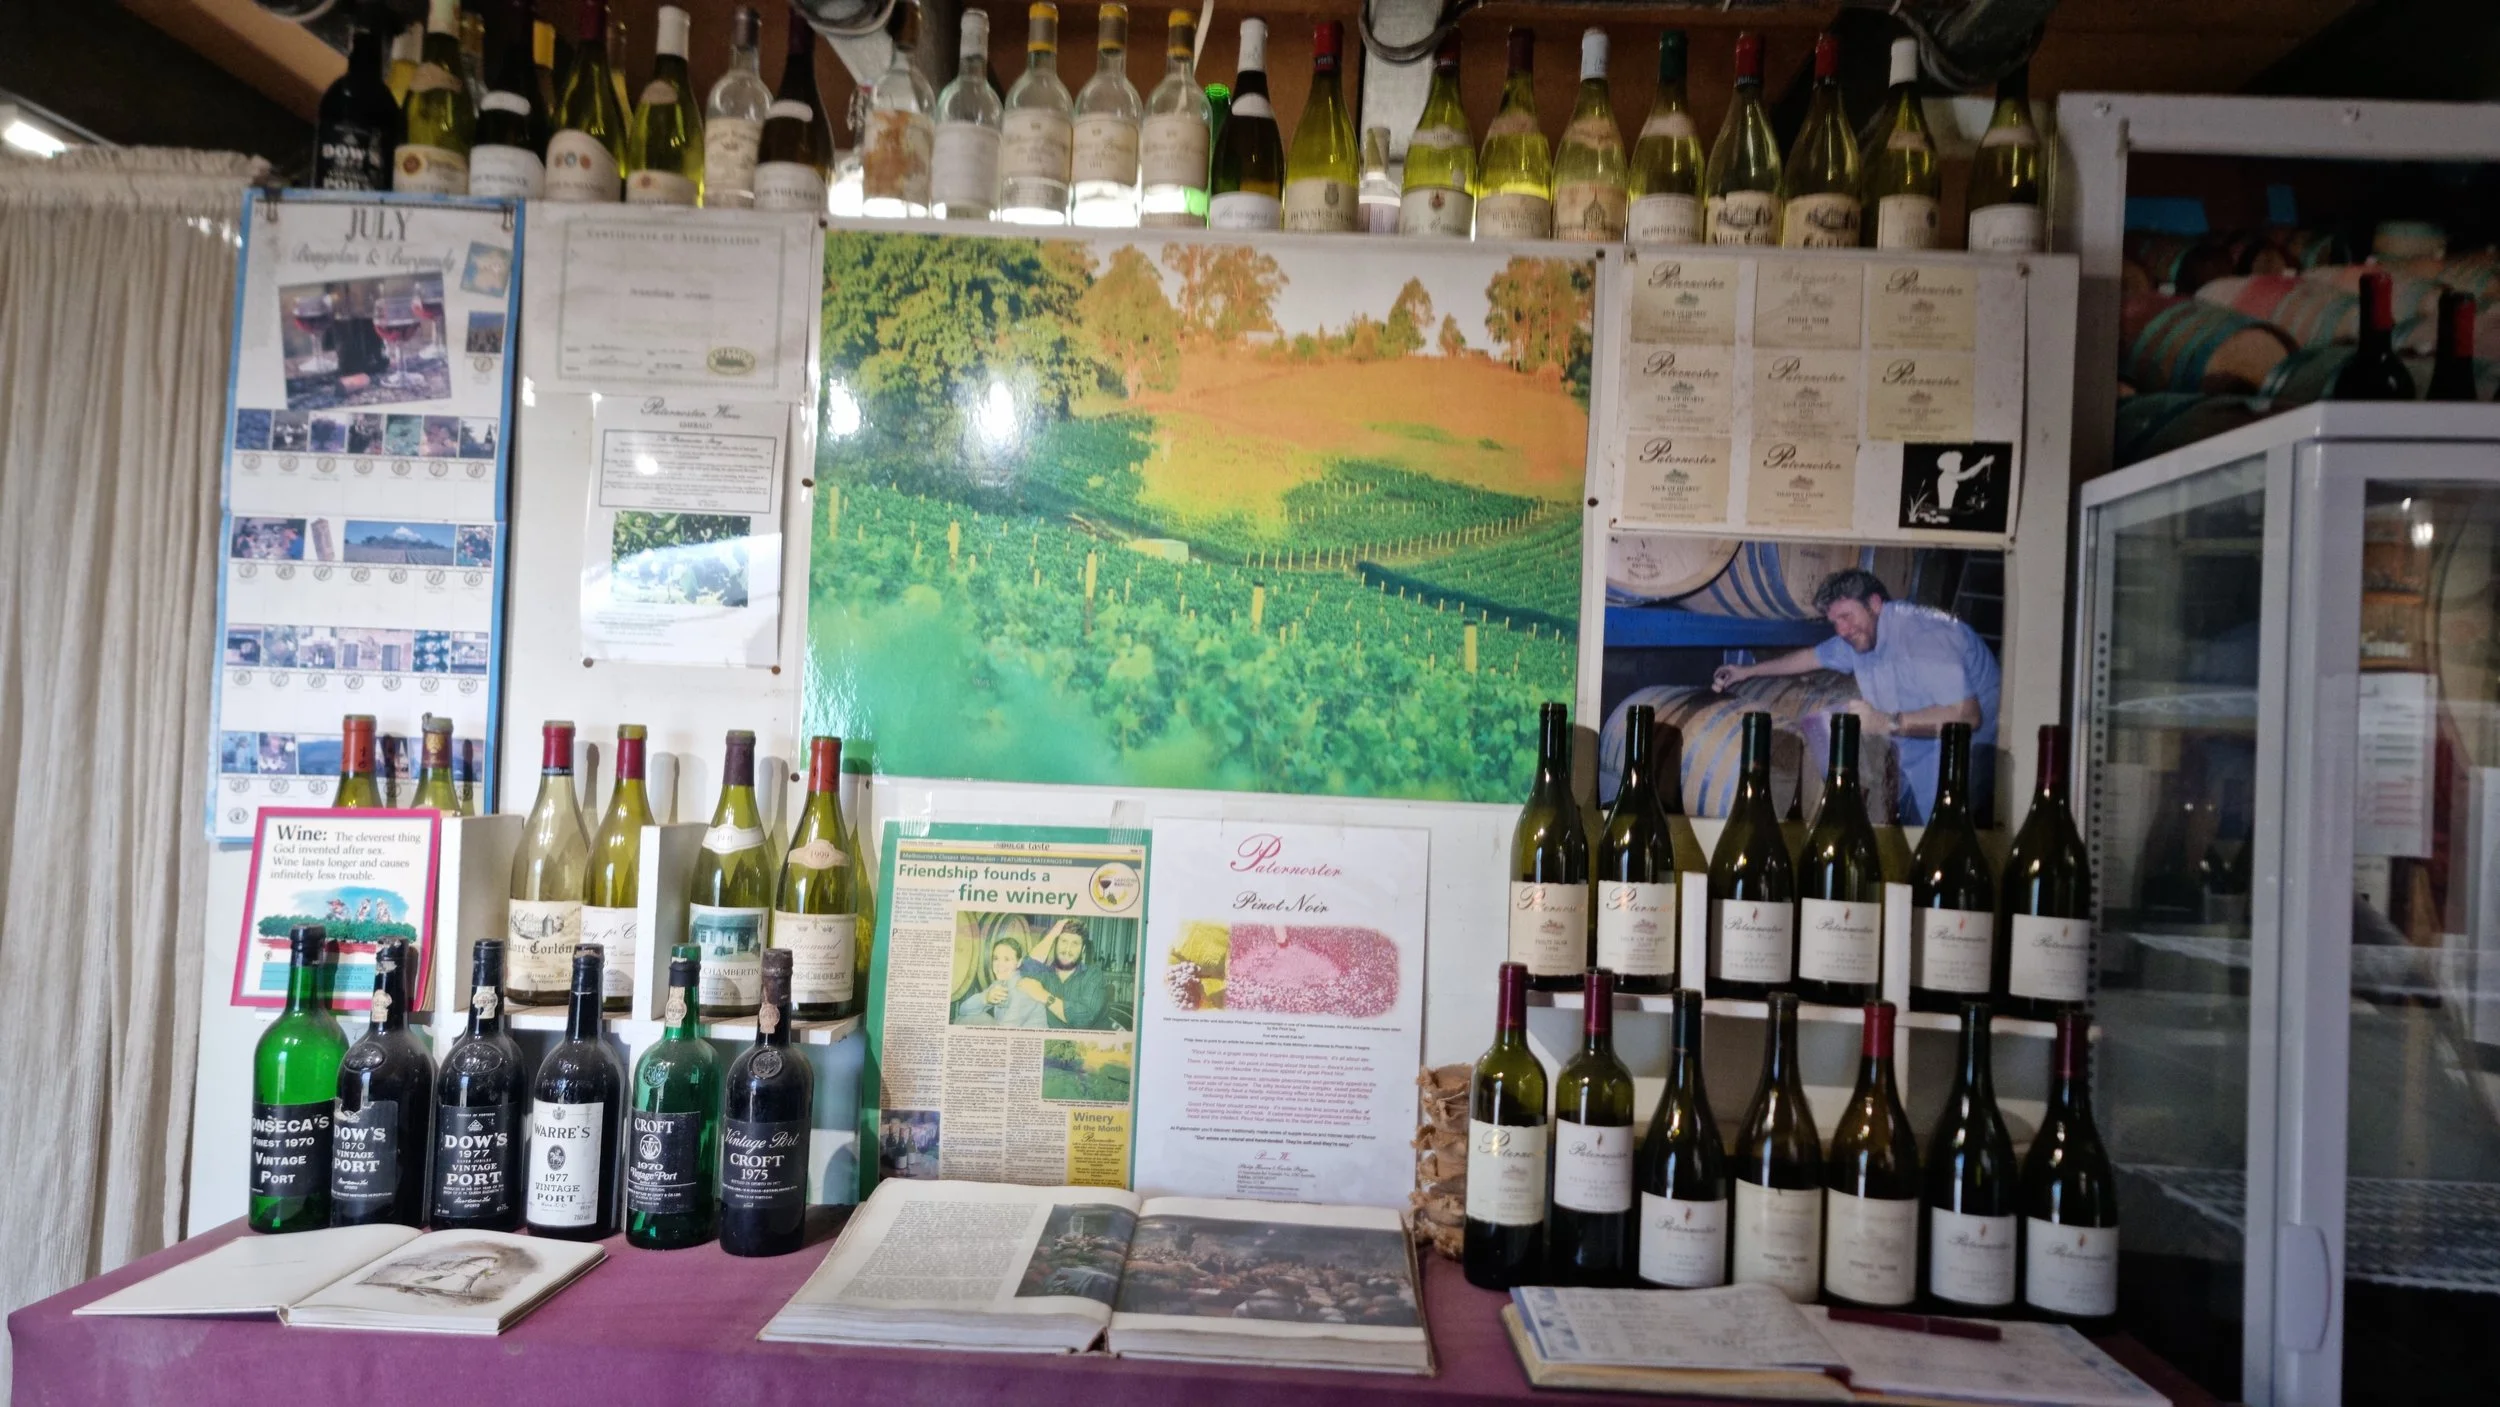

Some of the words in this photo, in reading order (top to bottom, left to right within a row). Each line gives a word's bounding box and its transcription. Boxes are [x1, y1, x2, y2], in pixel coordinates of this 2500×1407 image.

[346, 208, 413, 241] JULY
[1639, 437, 1716, 464] Paternoster
[1763, 442, 1841, 469] Paternoster
[277, 824, 327, 842] Wine:
[335, 831, 354, 842] The
[356, 832, 395, 843] cleverest
[398, 832, 421, 845] thing
[273, 844, 295, 854] God
[298, 845, 340, 855] invented
[342, 845, 365, 855] after
[367, 847, 385, 855] sex.
[1028, 843, 1050, 851] taste
[1033, 857, 1073, 865] PATERNOSTER
[1230, 833, 1342, 877] Paternoster
[273, 856, 299, 866] Wine
[302, 857, 325, 867] lasts
[328, 857, 357, 869] longer
[359, 858, 377, 868] and
[379, 859, 410, 868] causes
[270, 869, 314, 881] infinitely
[317, 870, 336, 880] less
[339, 871, 375, 881] trouble.
[899, 863, 978, 882] Friendship
[984, 866, 1036, 882] founds
[1042, 873, 1050, 882] a
[958, 883, 998, 903] fine
[1007, 885, 1078, 910] winery
[1232, 890, 1285, 911] Pinot
[1285, 893, 1329, 913] Noir
[704, 968, 760, 977] CHAMBERTIN
[1073, 1111, 1114, 1125] Winery
[534, 1123, 591, 1139] WARRE'S
[634, 1117, 675, 1134] CROFT
[1098, 1125, 1123, 1133] Month
[334, 1124, 386, 1142] DOW'S
[285, 1137, 315, 1148] 1970
[341, 1141, 366, 1150] 1970
[444, 1132, 508, 1149] DOW'S
[725, 1127, 767, 1155] Vintage
[769, 1131, 800, 1149] Port
[337, 1149, 374, 1159] VINTAGE
[459, 1149, 490, 1158] 1977
[730, 1152, 785, 1168] CROFT
[334, 1158, 380, 1173] PORT
[452, 1163, 498, 1172] VINTAGE
[637, 1161, 664, 1171] 1970
[446, 1171, 502, 1186] PORT
[545, 1173, 569, 1182] 1977
[630, 1166, 654, 1181] Vintage
[654, 1171, 678, 1181] Port
[741, 1168, 769, 1181] 1975
[535, 1182, 580, 1193] VINTAGE
[537, 1193, 576, 1202] PORT
